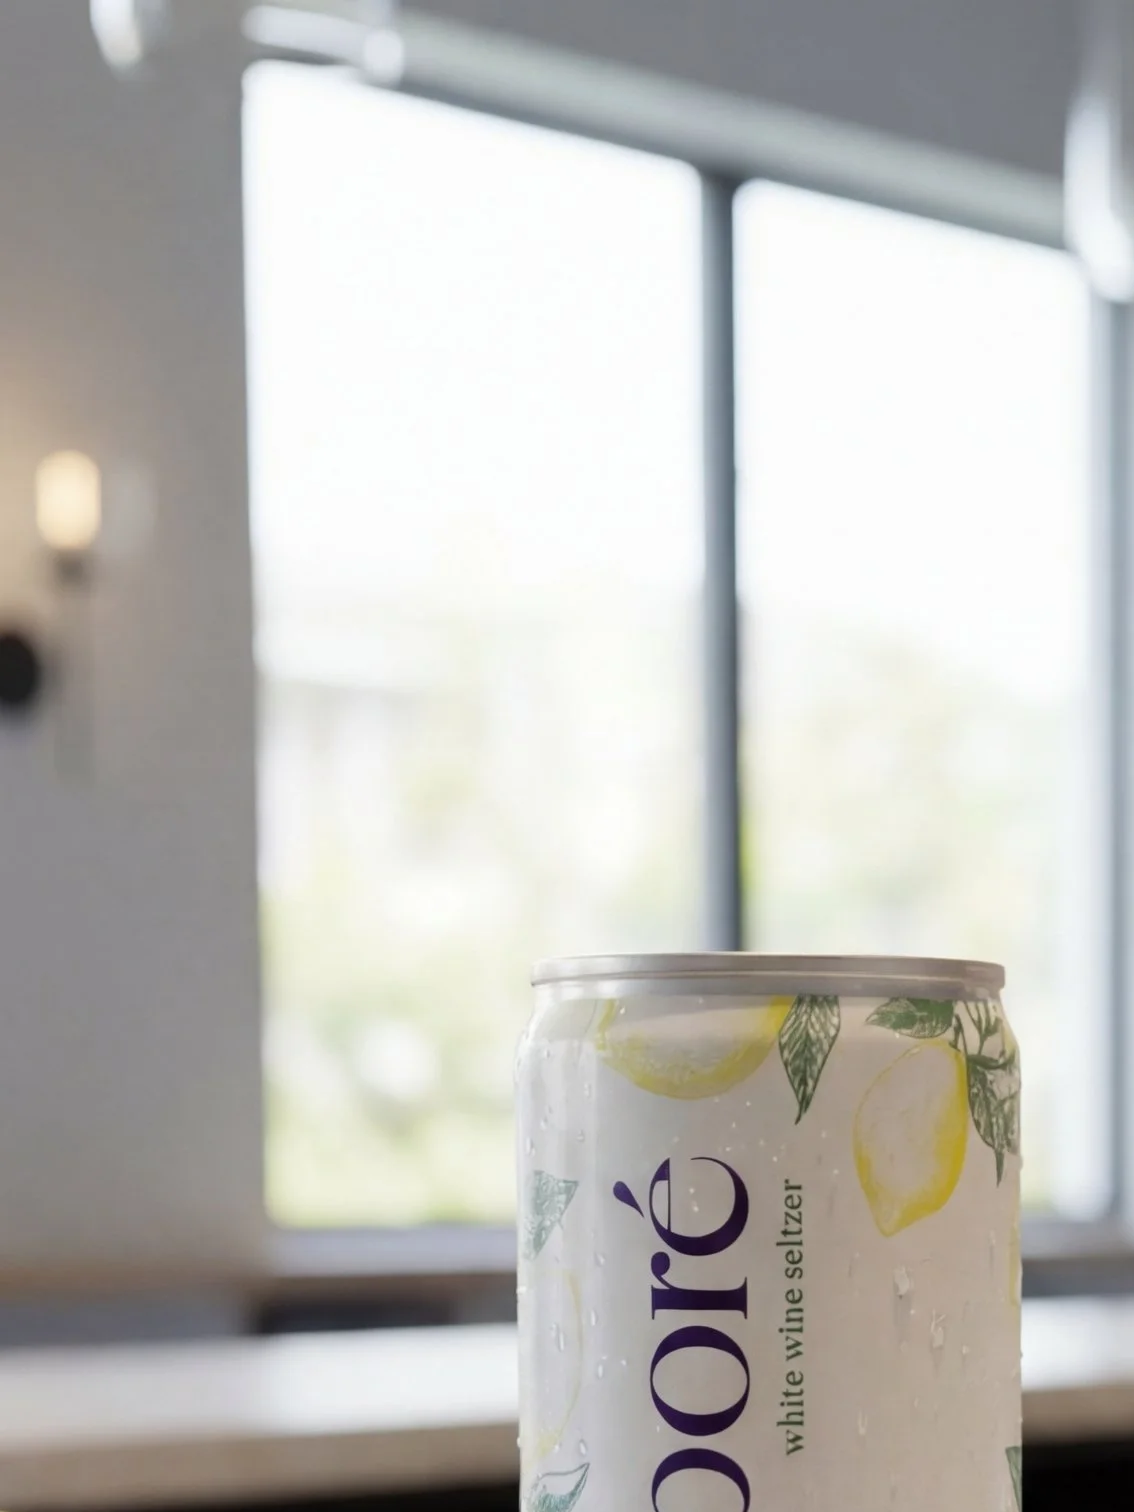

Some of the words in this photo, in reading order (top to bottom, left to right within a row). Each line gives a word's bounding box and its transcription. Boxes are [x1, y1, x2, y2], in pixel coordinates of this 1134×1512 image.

[775, 1178, 803, 1280] seltzer
[777, 1287, 804, 1362] wine
[776, 1369, 805, 1457] white
